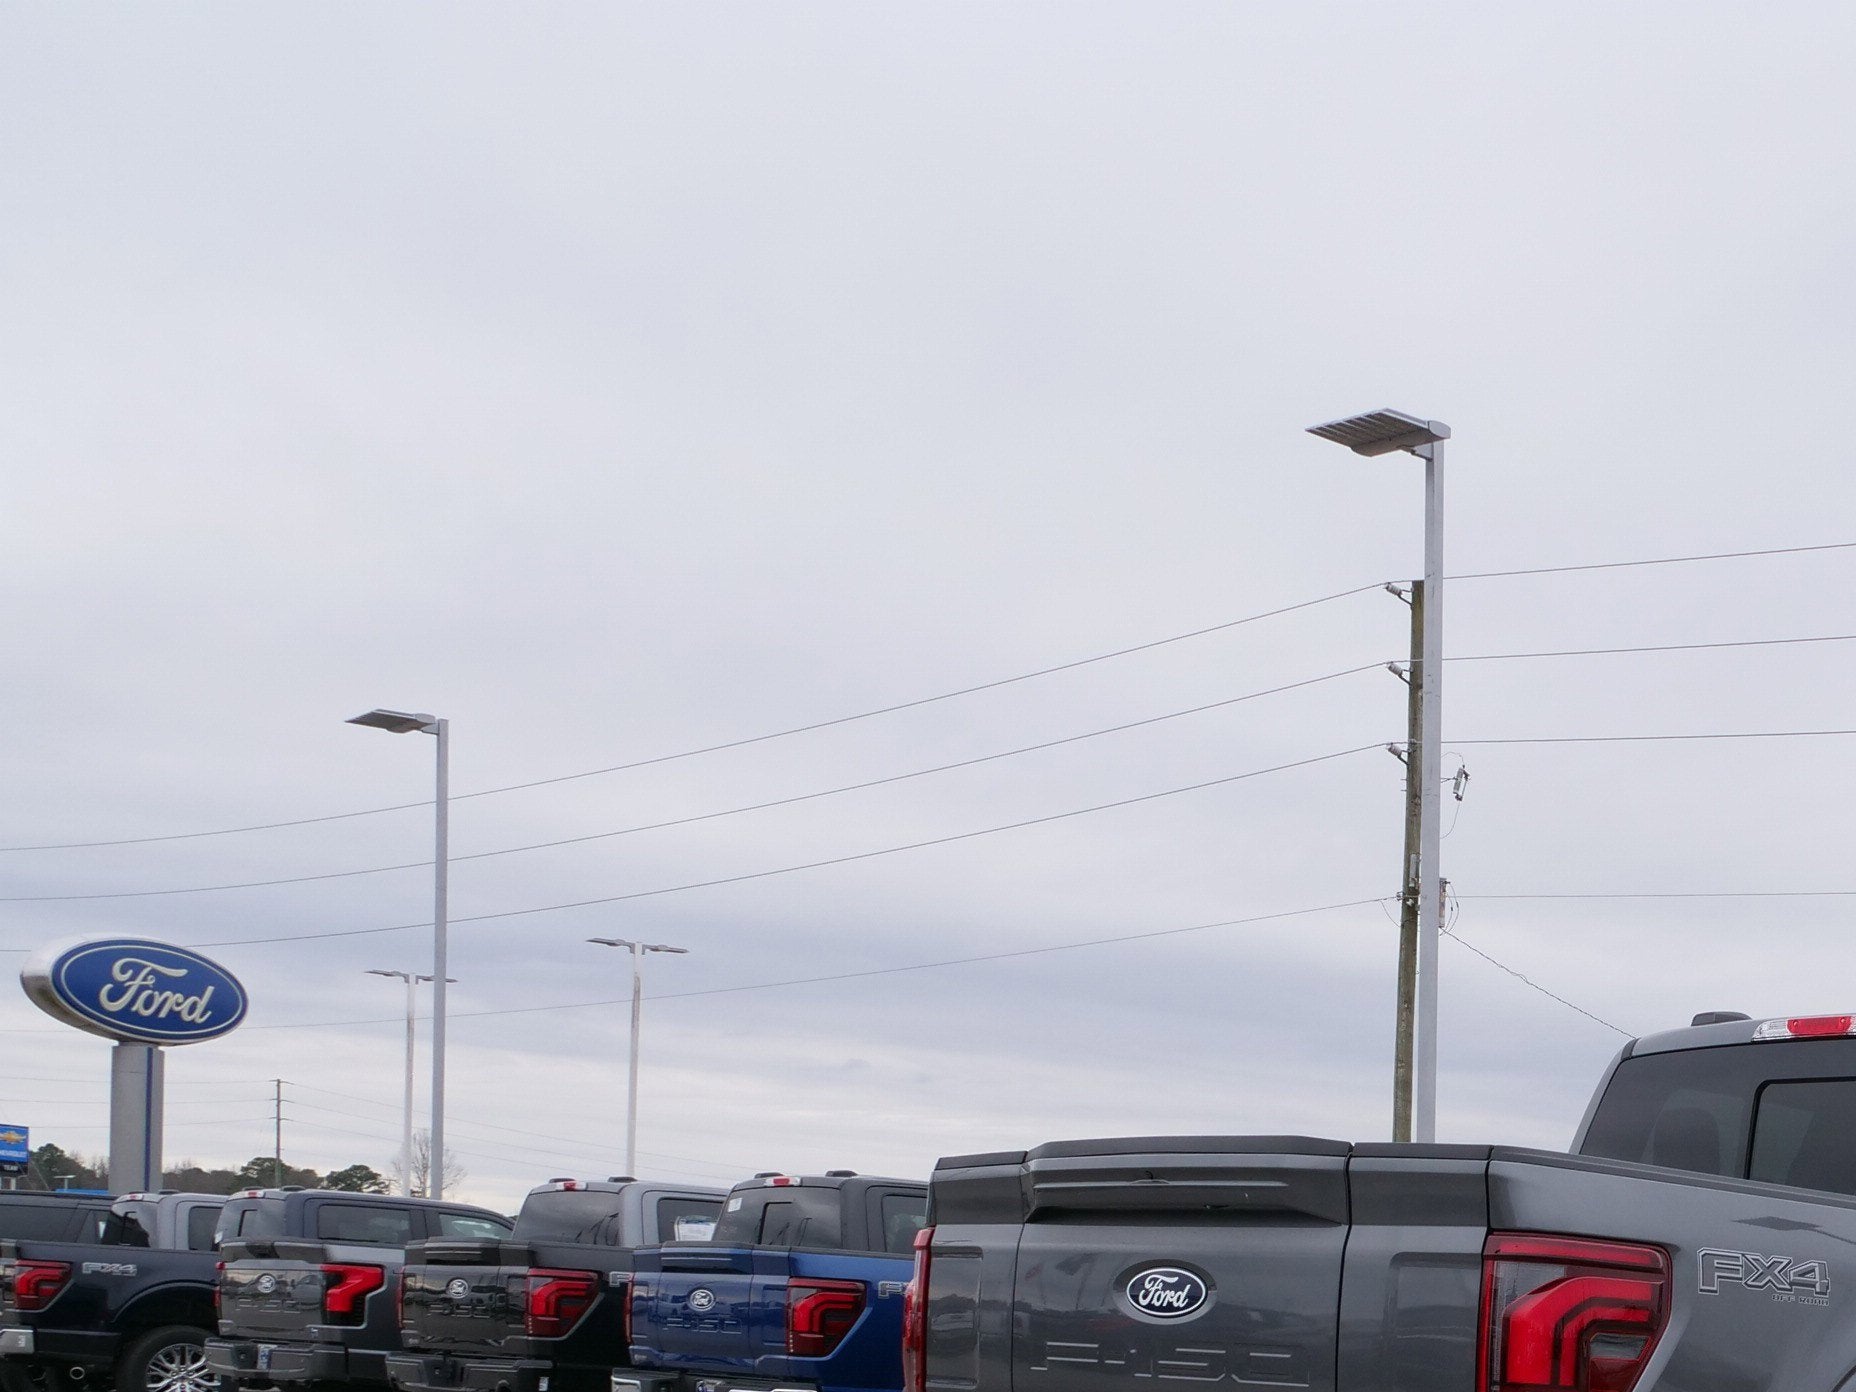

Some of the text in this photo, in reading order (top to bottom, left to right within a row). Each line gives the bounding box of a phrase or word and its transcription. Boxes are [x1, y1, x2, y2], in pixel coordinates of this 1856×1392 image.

[99, 957, 215, 1024] Ford
[82, 1262, 137, 1277] FX4
[1138, 1274, 1192, 1308] Ford
[1697, 1247, 1831, 1298] FX4
[1029, 1334, 1310, 1387] F-150
